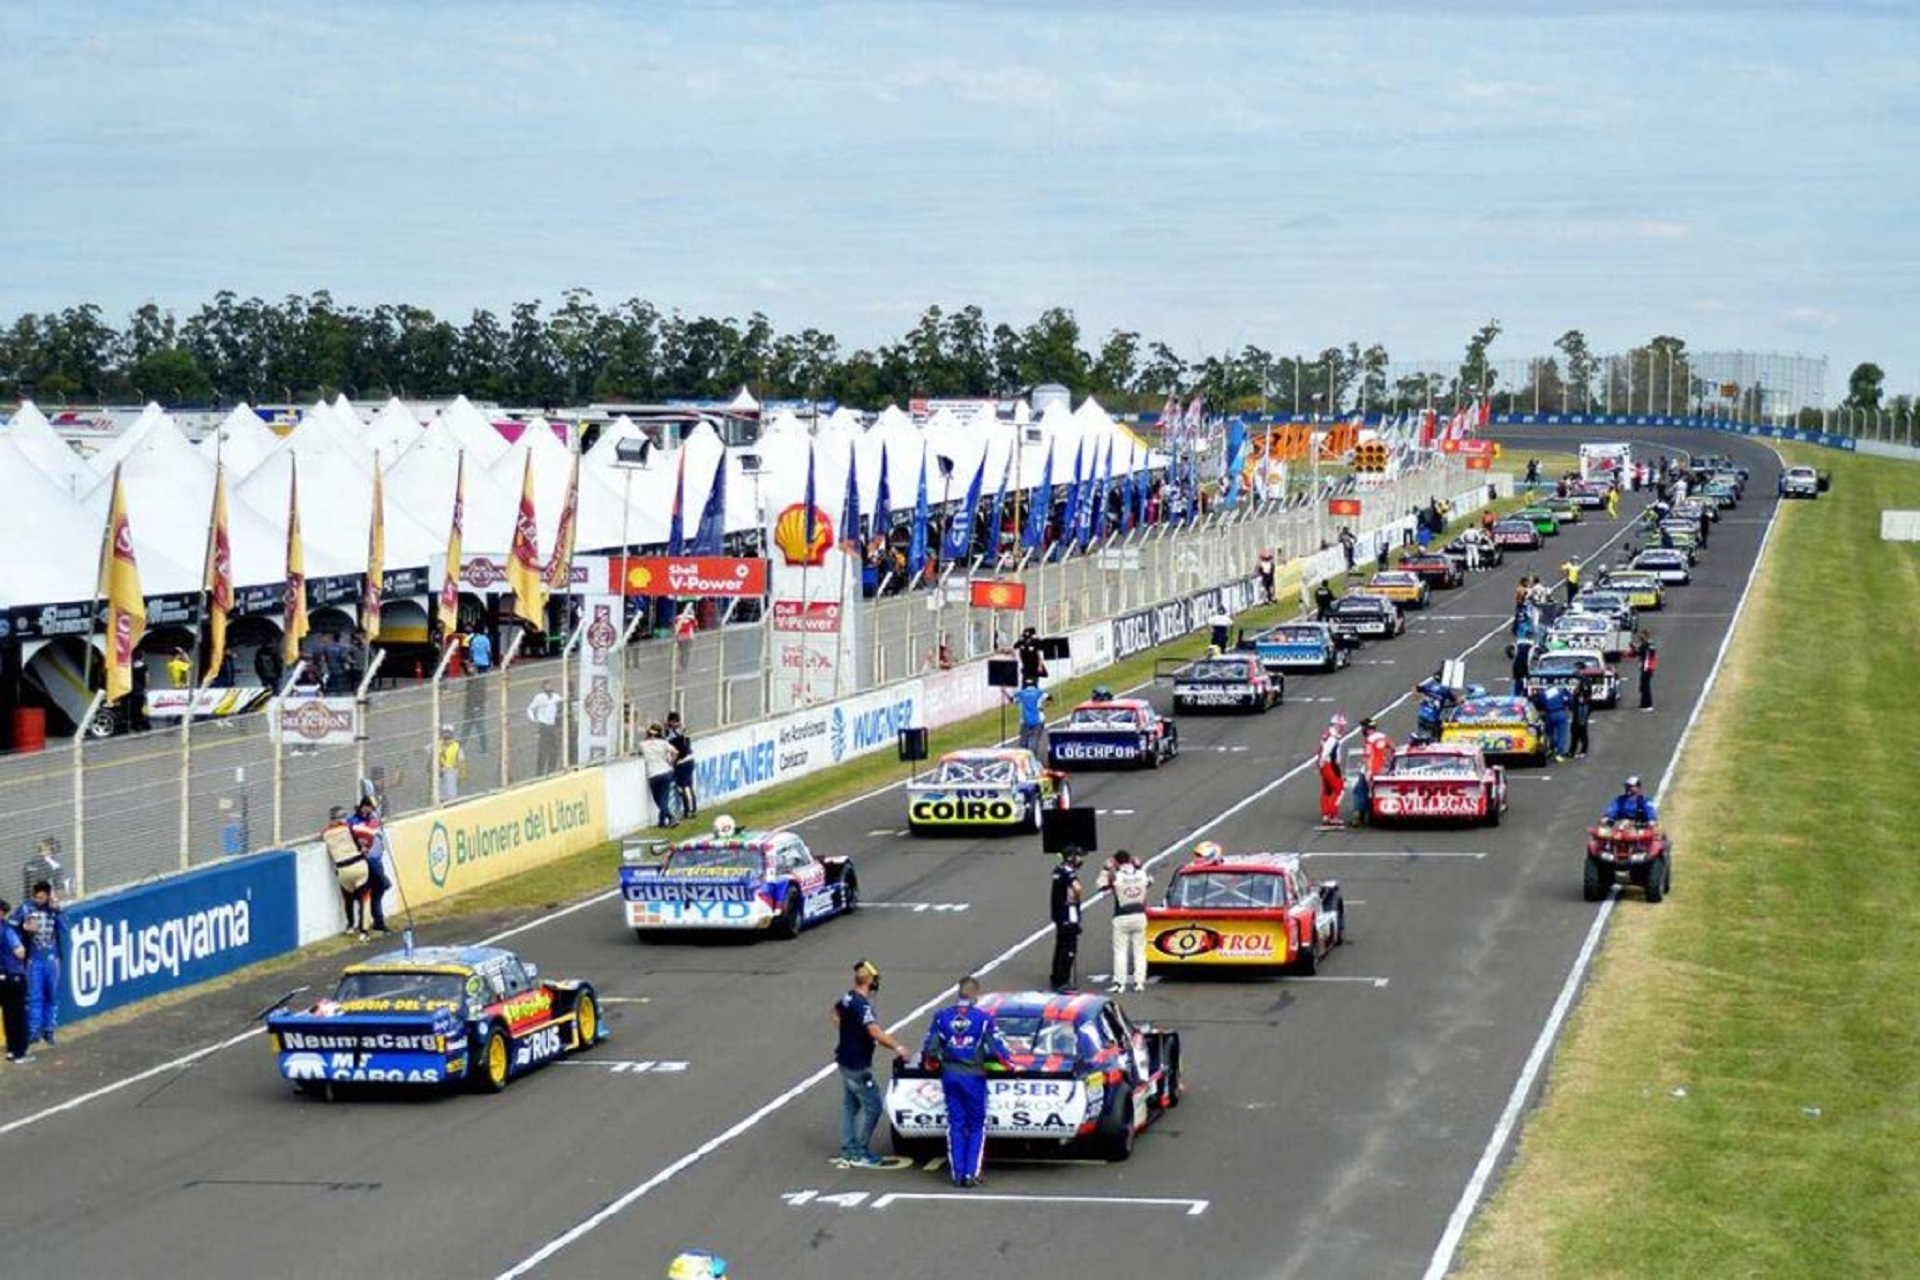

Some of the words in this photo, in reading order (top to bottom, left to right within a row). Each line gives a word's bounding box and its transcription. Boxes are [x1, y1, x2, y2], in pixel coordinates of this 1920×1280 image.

[668, 564, 698, 574] Shell
[668, 577, 744, 590] V-Power
[913, 802, 1012, 820] COIRO
[456, 820, 520, 864] Bulonera
[525, 804, 546, 841] del
[548, 792, 590, 834] Litoral
[627, 885, 746, 901] GUANZINI
[105, 899, 250, 986] Husqvarna
[532, 1026, 560, 1061] RUS
